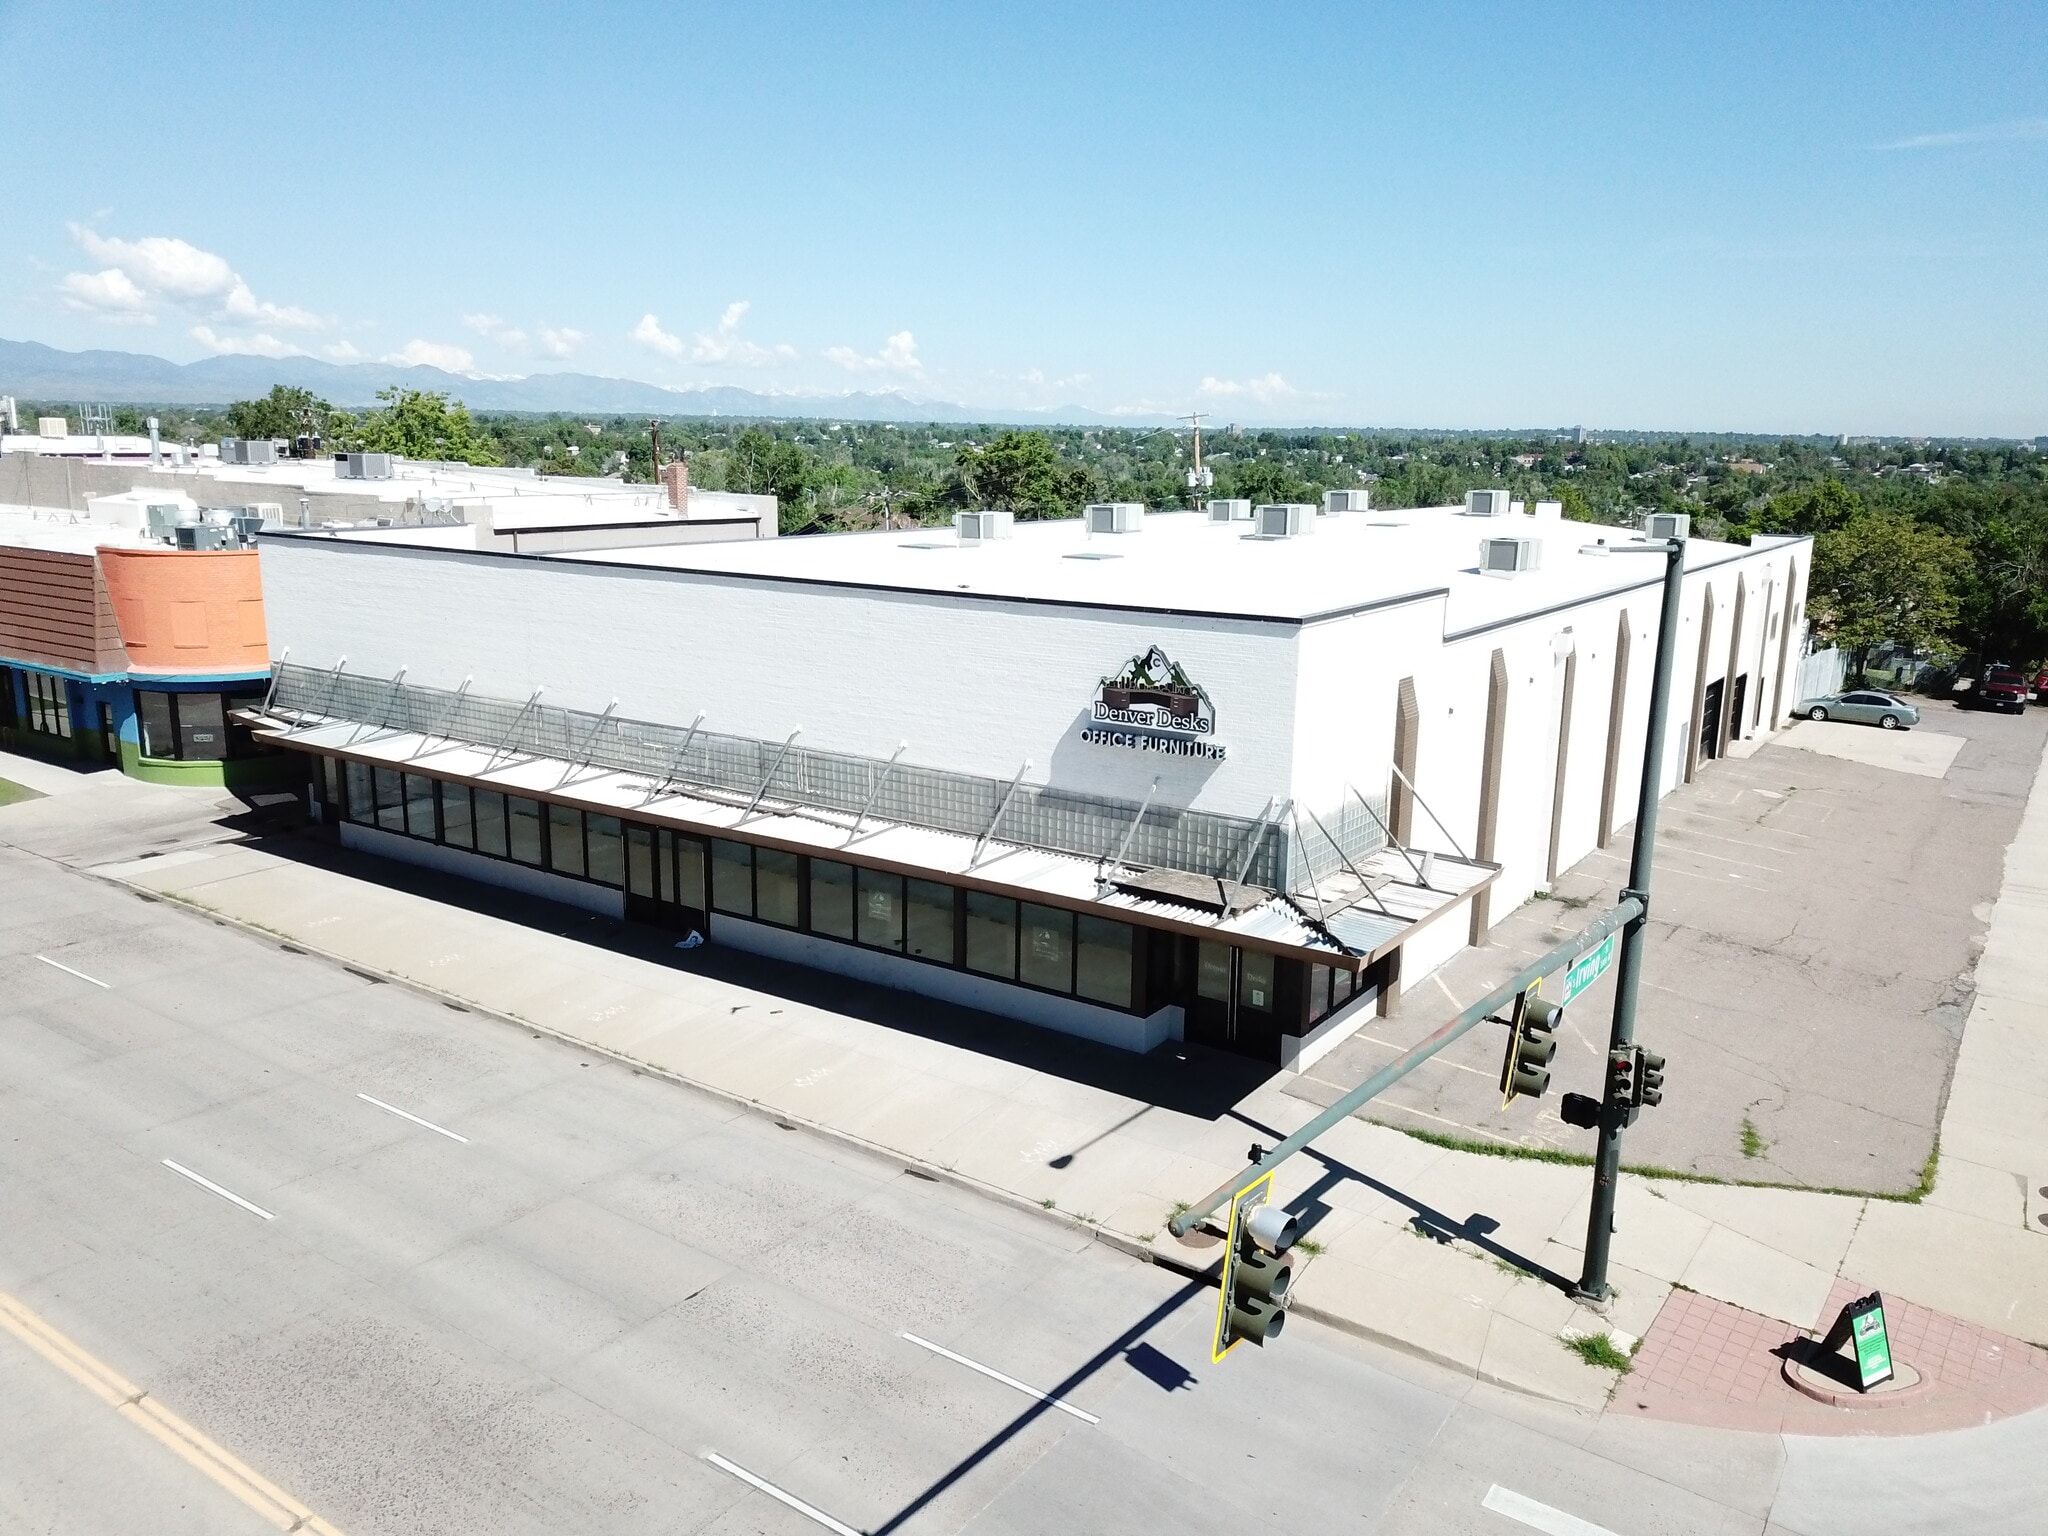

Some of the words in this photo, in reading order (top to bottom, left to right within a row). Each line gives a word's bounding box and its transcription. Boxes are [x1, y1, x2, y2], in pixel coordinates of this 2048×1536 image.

[1095, 702, 1155, 725] Denver
[1157, 708, 1209, 733] Desks
[1080, 728, 1135, 749] OFFICE
[1141, 735, 1226, 760] FURNITURE
[1575, 954, 1601, 989] Irving
